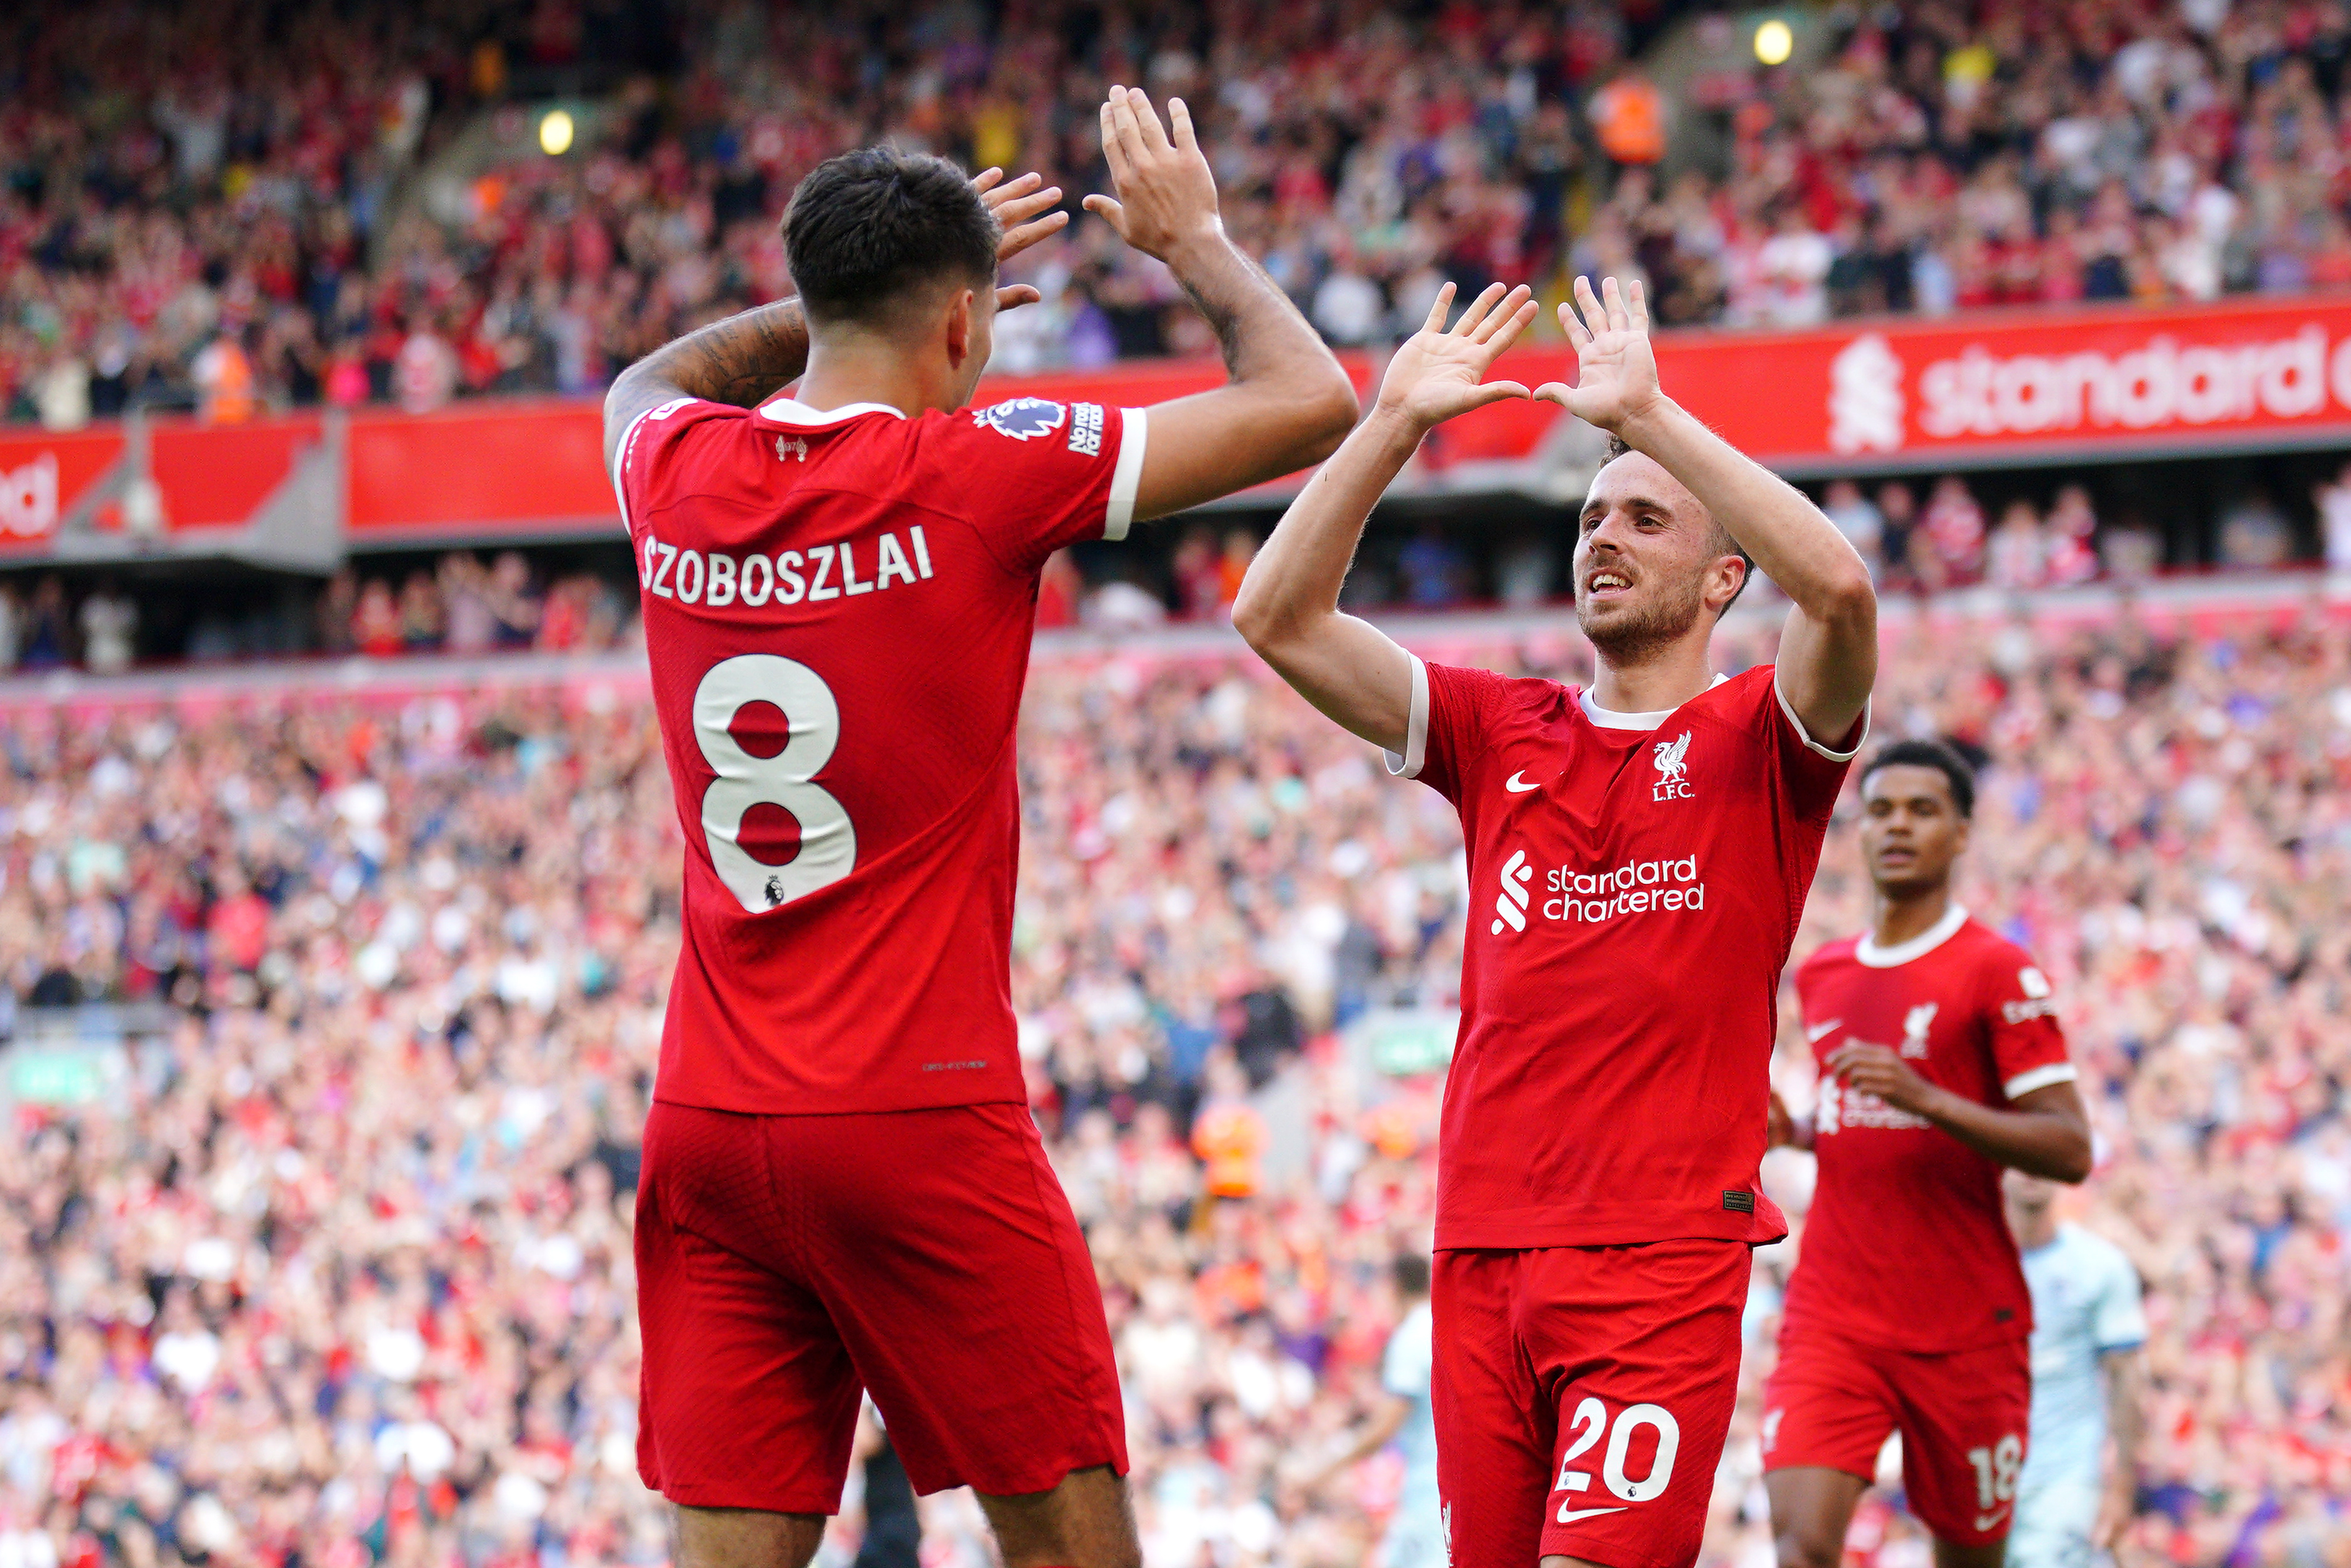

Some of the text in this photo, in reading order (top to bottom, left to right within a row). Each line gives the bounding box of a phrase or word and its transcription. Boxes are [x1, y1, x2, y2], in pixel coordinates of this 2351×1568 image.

[1918, 323, 2329, 438] standard
[640, 525, 934, 608] SZOBOSZLAI
[693, 653, 857, 915] 8
[1652, 782, 1695, 802] L.F.C.
[1543, 882, 1704, 923] chartered
[1547, 854, 1696, 894] standard
[1554, 1397, 1680, 1502] 20
[1968, 1433, 2022, 1510] 18
